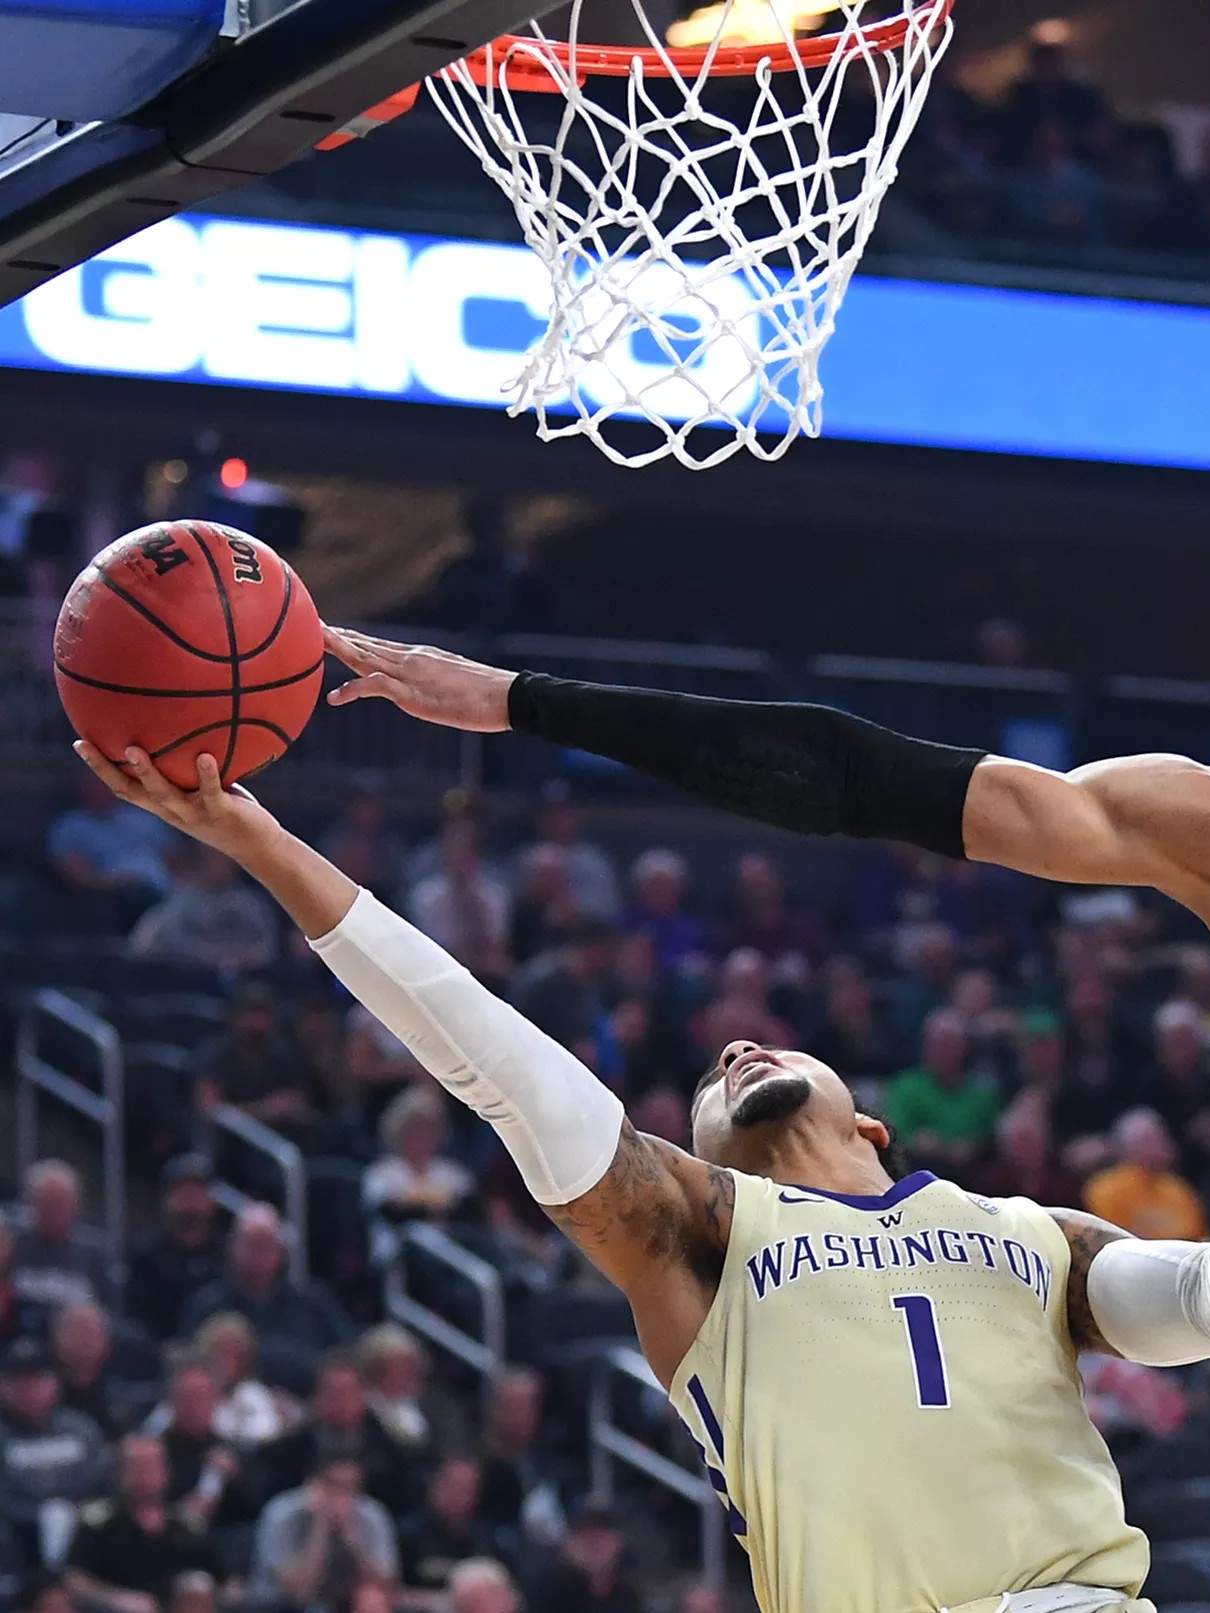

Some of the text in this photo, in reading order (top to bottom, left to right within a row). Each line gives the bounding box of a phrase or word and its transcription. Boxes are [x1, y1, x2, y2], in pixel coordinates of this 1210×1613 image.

[876, 1210, 904, 1229] W
[745, 1228, 1052, 1315] WASHINGTON
[889, 1293, 951, 1410] 1
